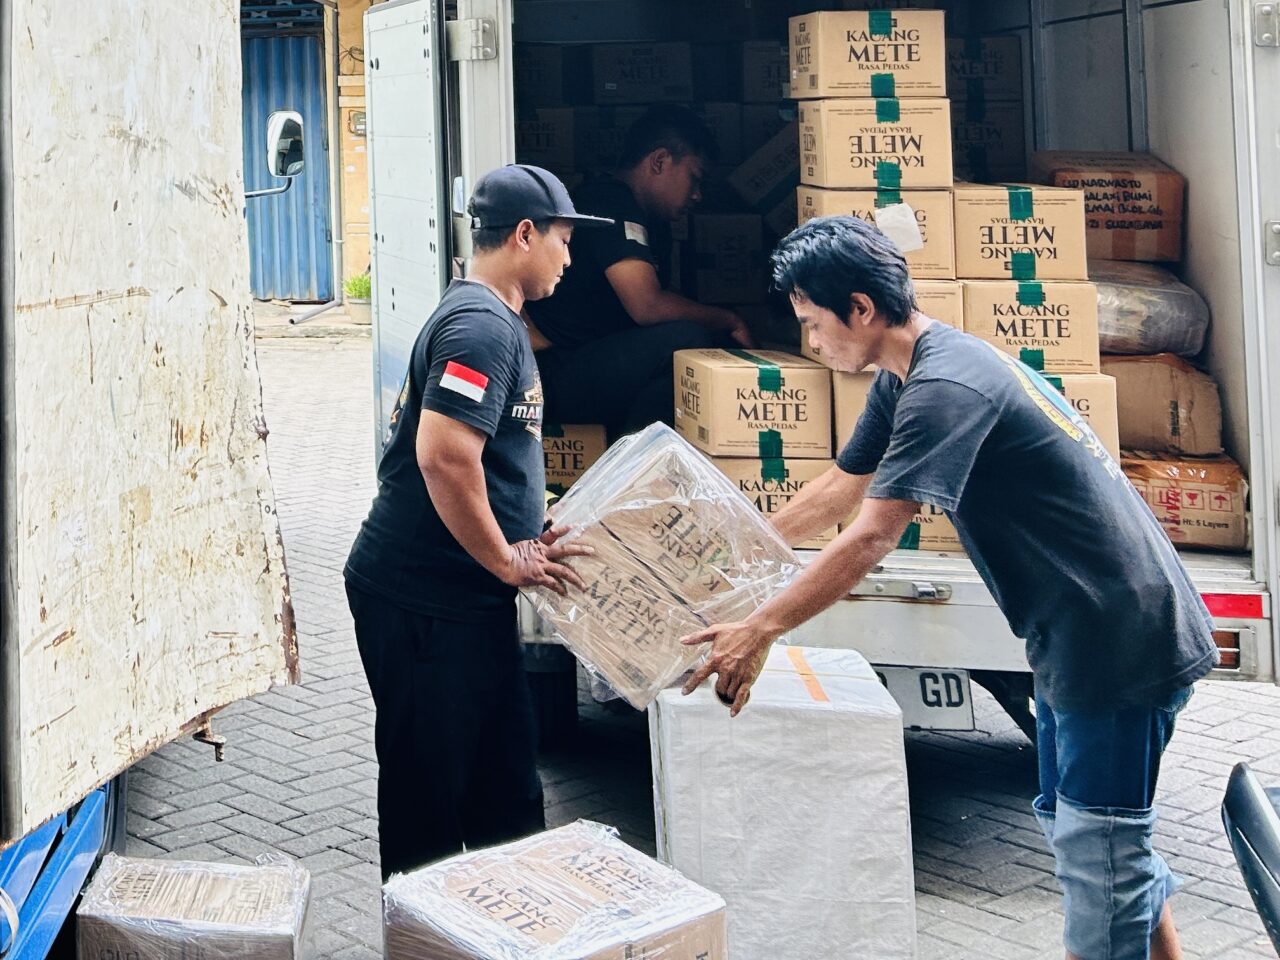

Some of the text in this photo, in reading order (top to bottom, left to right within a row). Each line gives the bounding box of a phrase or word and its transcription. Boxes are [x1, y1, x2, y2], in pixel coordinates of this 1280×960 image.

[795, 46, 812, 66] METE
[847, 43, 921, 63] METE
[858, 63, 910, 71] RASA PEDAS
[859, 126, 913, 135] RASA PEDAS
[848, 134, 924, 155] METE
[851, 209, 926, 223] KAG
[979, 225, 1056, 245] METE
[992, 303, 1070, 317] KACANG
[994, 318, 1071, 338] METE
[1005, 338, 1060, 347] RASA PEDAS
[681, 390, 701, 415] METE
[736, 388, 808, 402] KACANG
[737, 402, 809, 423] METE
[747, 422, 798, 431] RASA PEDAS
[542, 439, 585, 452] CANG
[544, 452, 586, 470] ETE
[1203, 519, 1229, 529] Layers
[599, 565, 668, 635] KACANG
[587, 580, 657, 652] METE
[919, 672, 964, 708] GD
[457, 886, 547, 935] METE
[481, 877, 562, 926] KACANG
